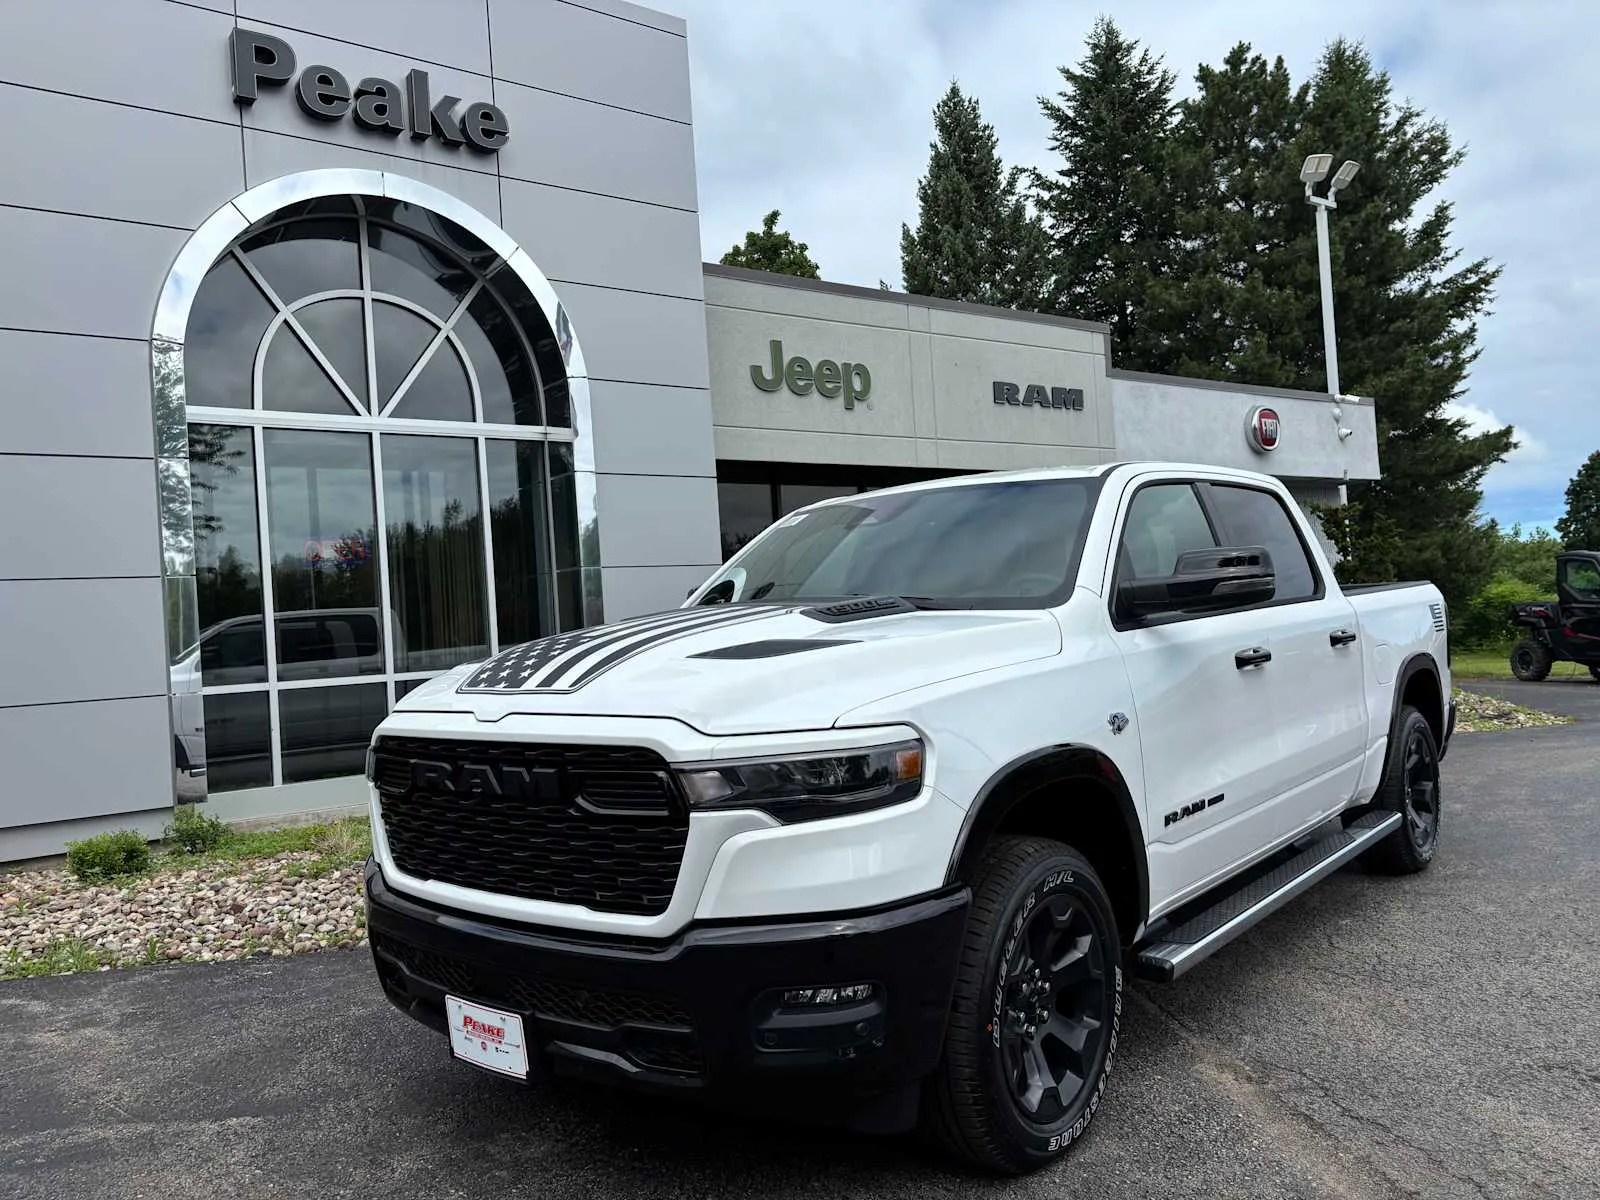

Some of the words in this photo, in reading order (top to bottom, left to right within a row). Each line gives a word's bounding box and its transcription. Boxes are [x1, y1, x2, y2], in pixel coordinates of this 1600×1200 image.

[229, 27, 509, 154] Peake
[750, 340, 871, 410] Jeep
[993, 381, 1084, 411] RAM
[410, 758, 561, 798] RAM
[1164, 799, 1206, 828] RAM
[463, 1015, 505, 1038] PEAKE
